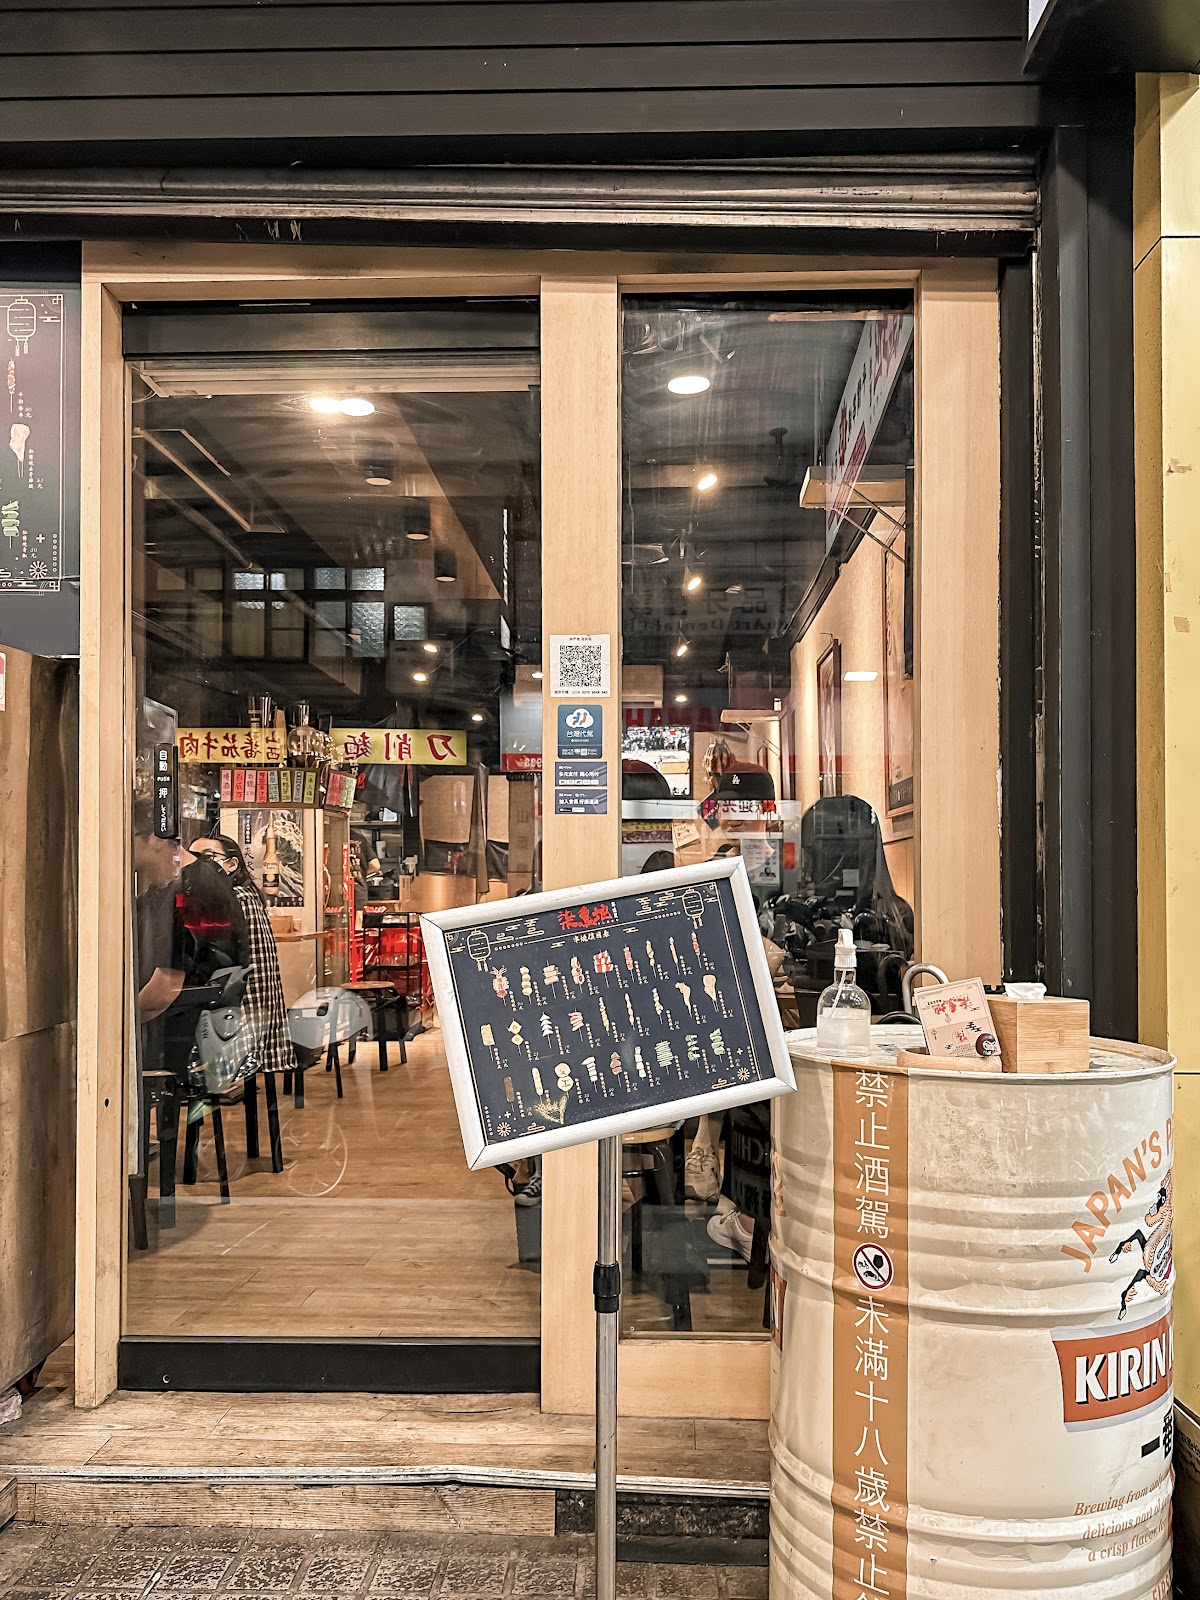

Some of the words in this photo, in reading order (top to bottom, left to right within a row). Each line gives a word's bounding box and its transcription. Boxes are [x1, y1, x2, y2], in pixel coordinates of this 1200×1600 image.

[158, 750, 168, 772] 自動
[854, 1069, 890, 1240] 禁止酒駕
[1061, 1130, 1162, 1274] JAPAN'S
[1075, 1333, 1167, 1404] KIRIN
[853, 1295, 891, 1600] 未滿十八歲禁止
[1074, 1496, 1125, 1516] Brewing
[1126, 1487, 1149, 1504] from
[1082, 1514, 1134, 1540] delicious
[1134, 1507, 1152, 1529] part
[1088, 1550, 1096, 1562] a
[1100, 1541, 1129, 1558] crisp
[1131, 1526, 1158, 1550] flavor
